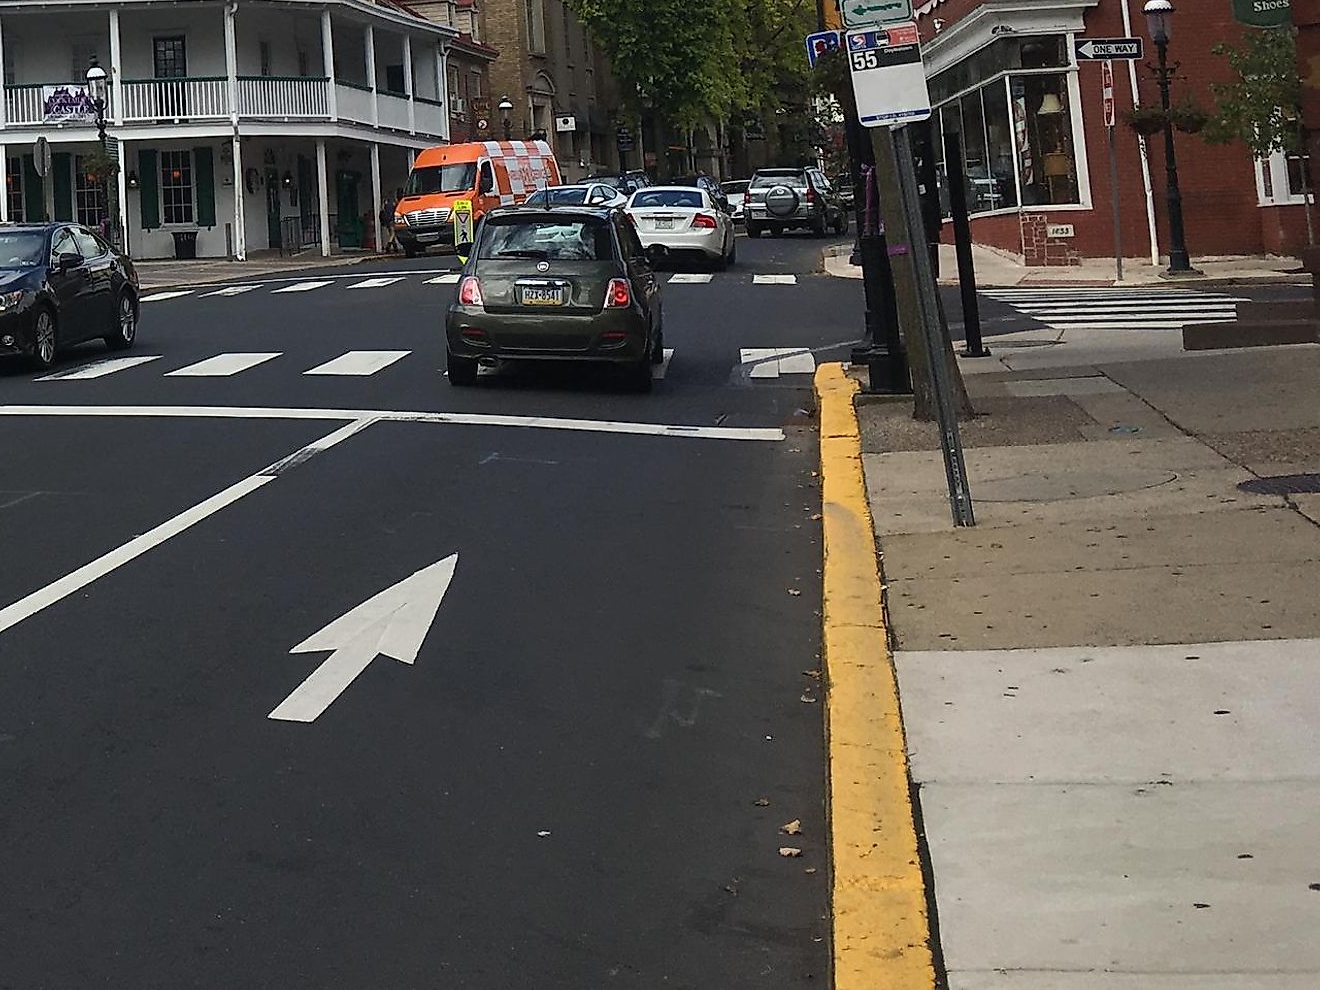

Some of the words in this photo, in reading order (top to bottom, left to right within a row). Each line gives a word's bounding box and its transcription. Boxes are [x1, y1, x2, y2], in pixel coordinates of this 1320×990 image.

[1253, 0, 1290, 12] Shoes
[1093, 45, 1113, 54] ONE
[1115, 44, 1134, 53] WAY
[853, 50, 878, 70] 55
